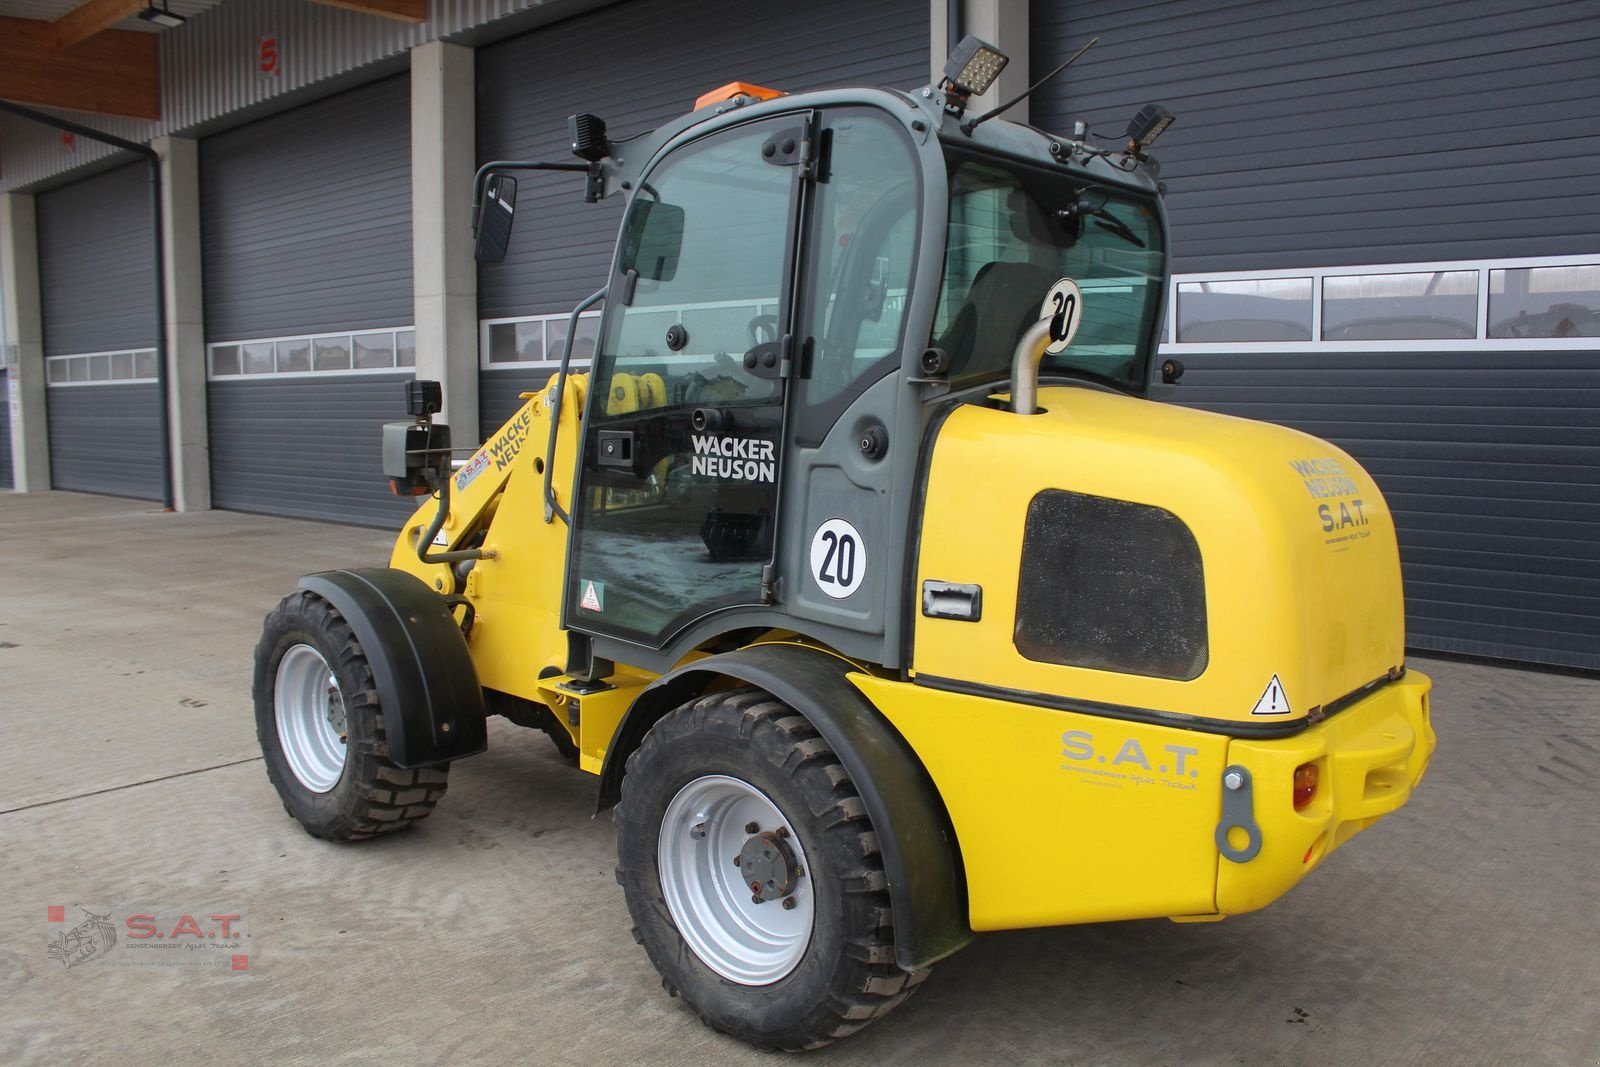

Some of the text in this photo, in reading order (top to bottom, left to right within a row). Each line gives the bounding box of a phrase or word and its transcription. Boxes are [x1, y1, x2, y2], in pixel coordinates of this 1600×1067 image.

[260, 37, 277, 73] 5
[489, 406, 531, 458] WACKE
[691, 434, 776, 461] WACKER
[692, 456, 775, 483] NEUSON
[1317, 499, 1369, 533] S.A.T.
[819, 530, 856, 588] 20
[1061, 730, 1199, 778] S.A.T.
